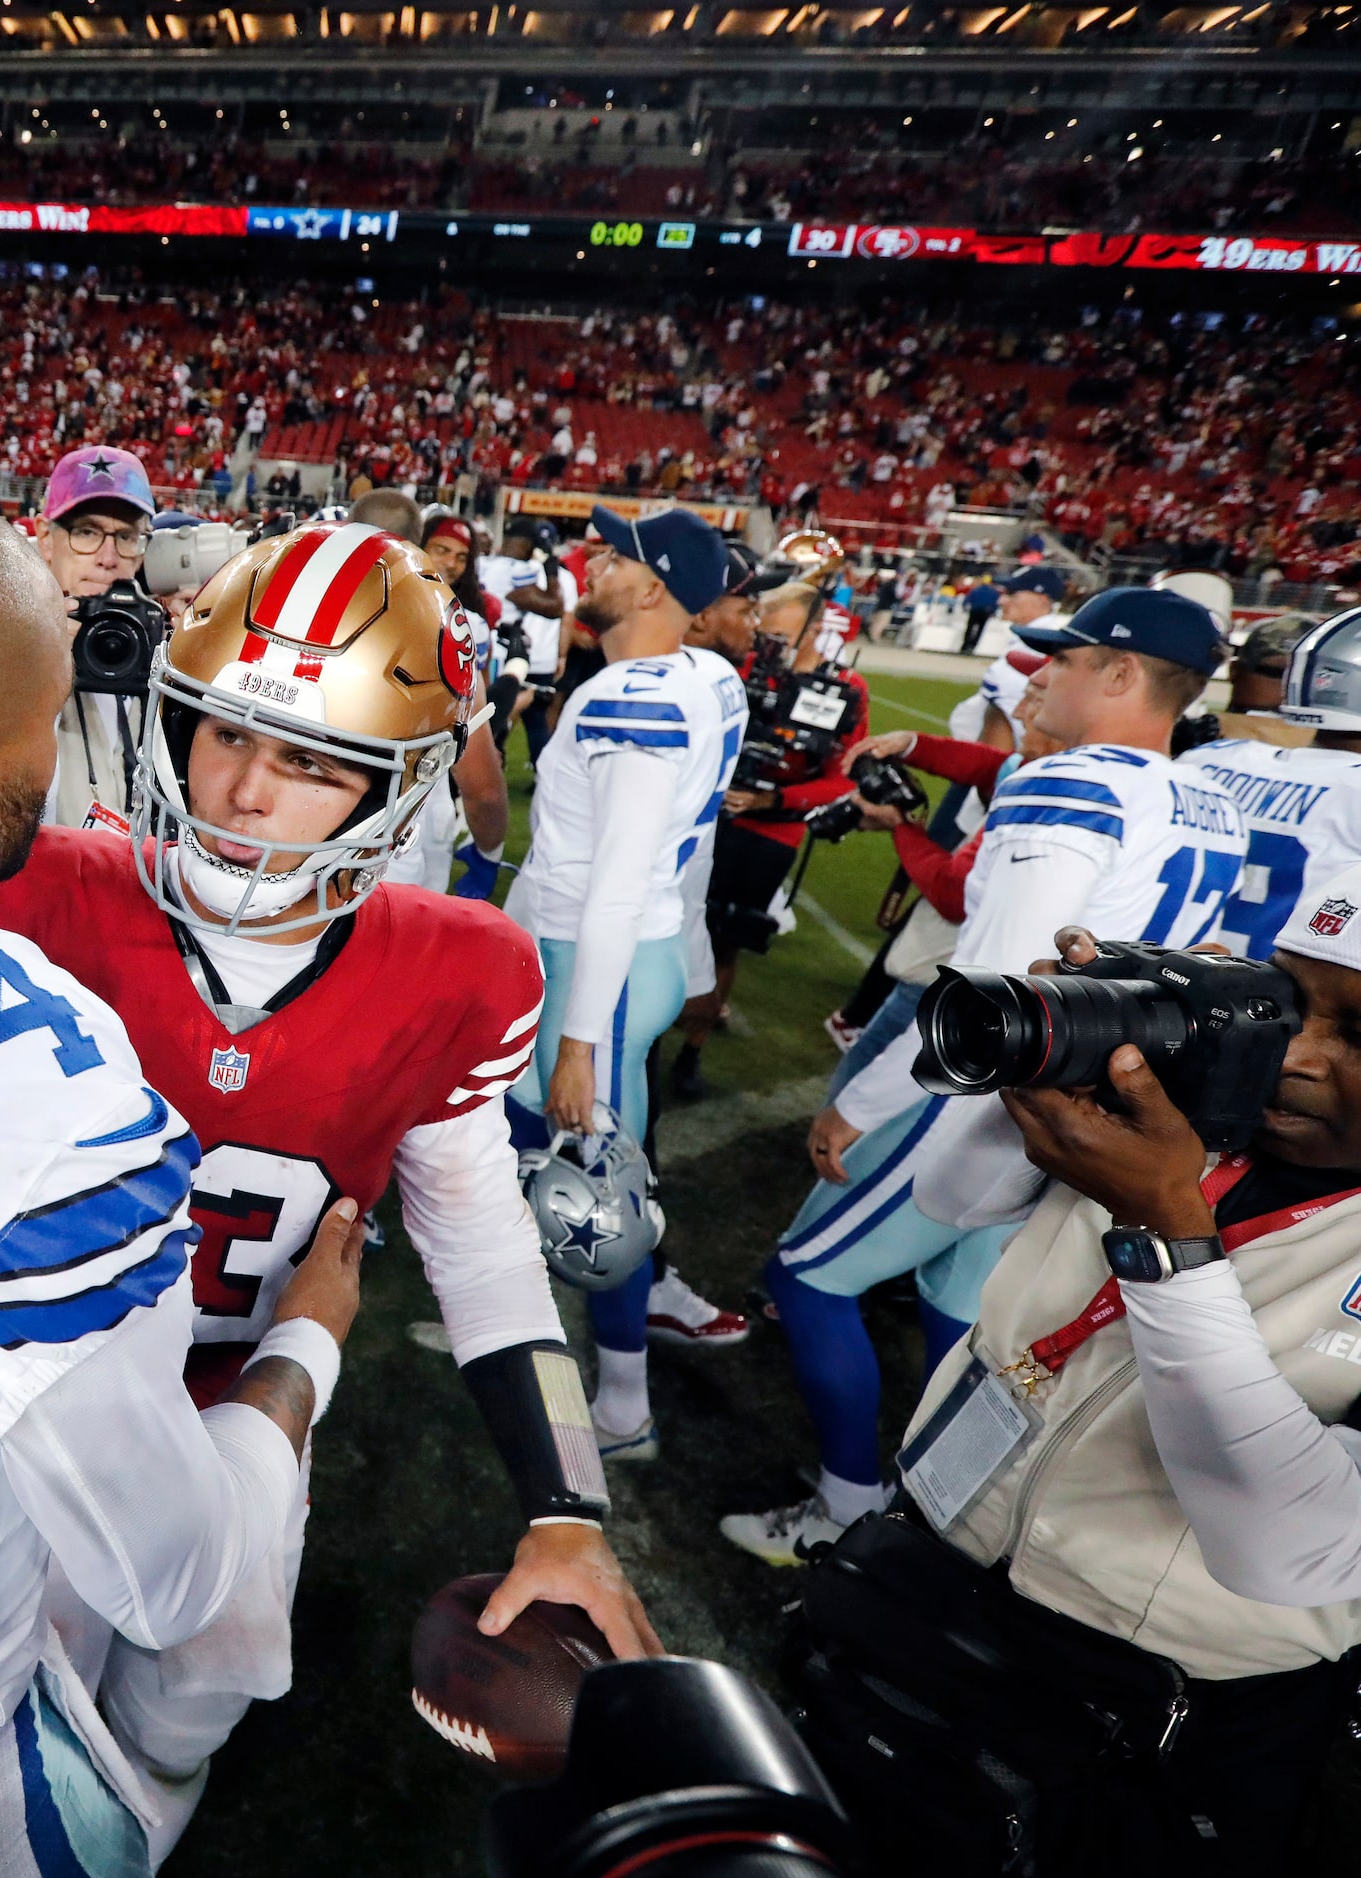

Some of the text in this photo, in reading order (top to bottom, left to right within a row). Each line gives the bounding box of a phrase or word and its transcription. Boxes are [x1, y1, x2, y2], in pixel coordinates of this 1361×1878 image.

[590, 221, 643, 246] 0:00
[1316, 243, 1361, 273] WI
[238, 671, 299, 705] 49ERS
[1311, 911, 1344, 935] NFL
[1210, 1007, 1231, 1020] EOS
[214, 1066, 240, 1085] NFL
